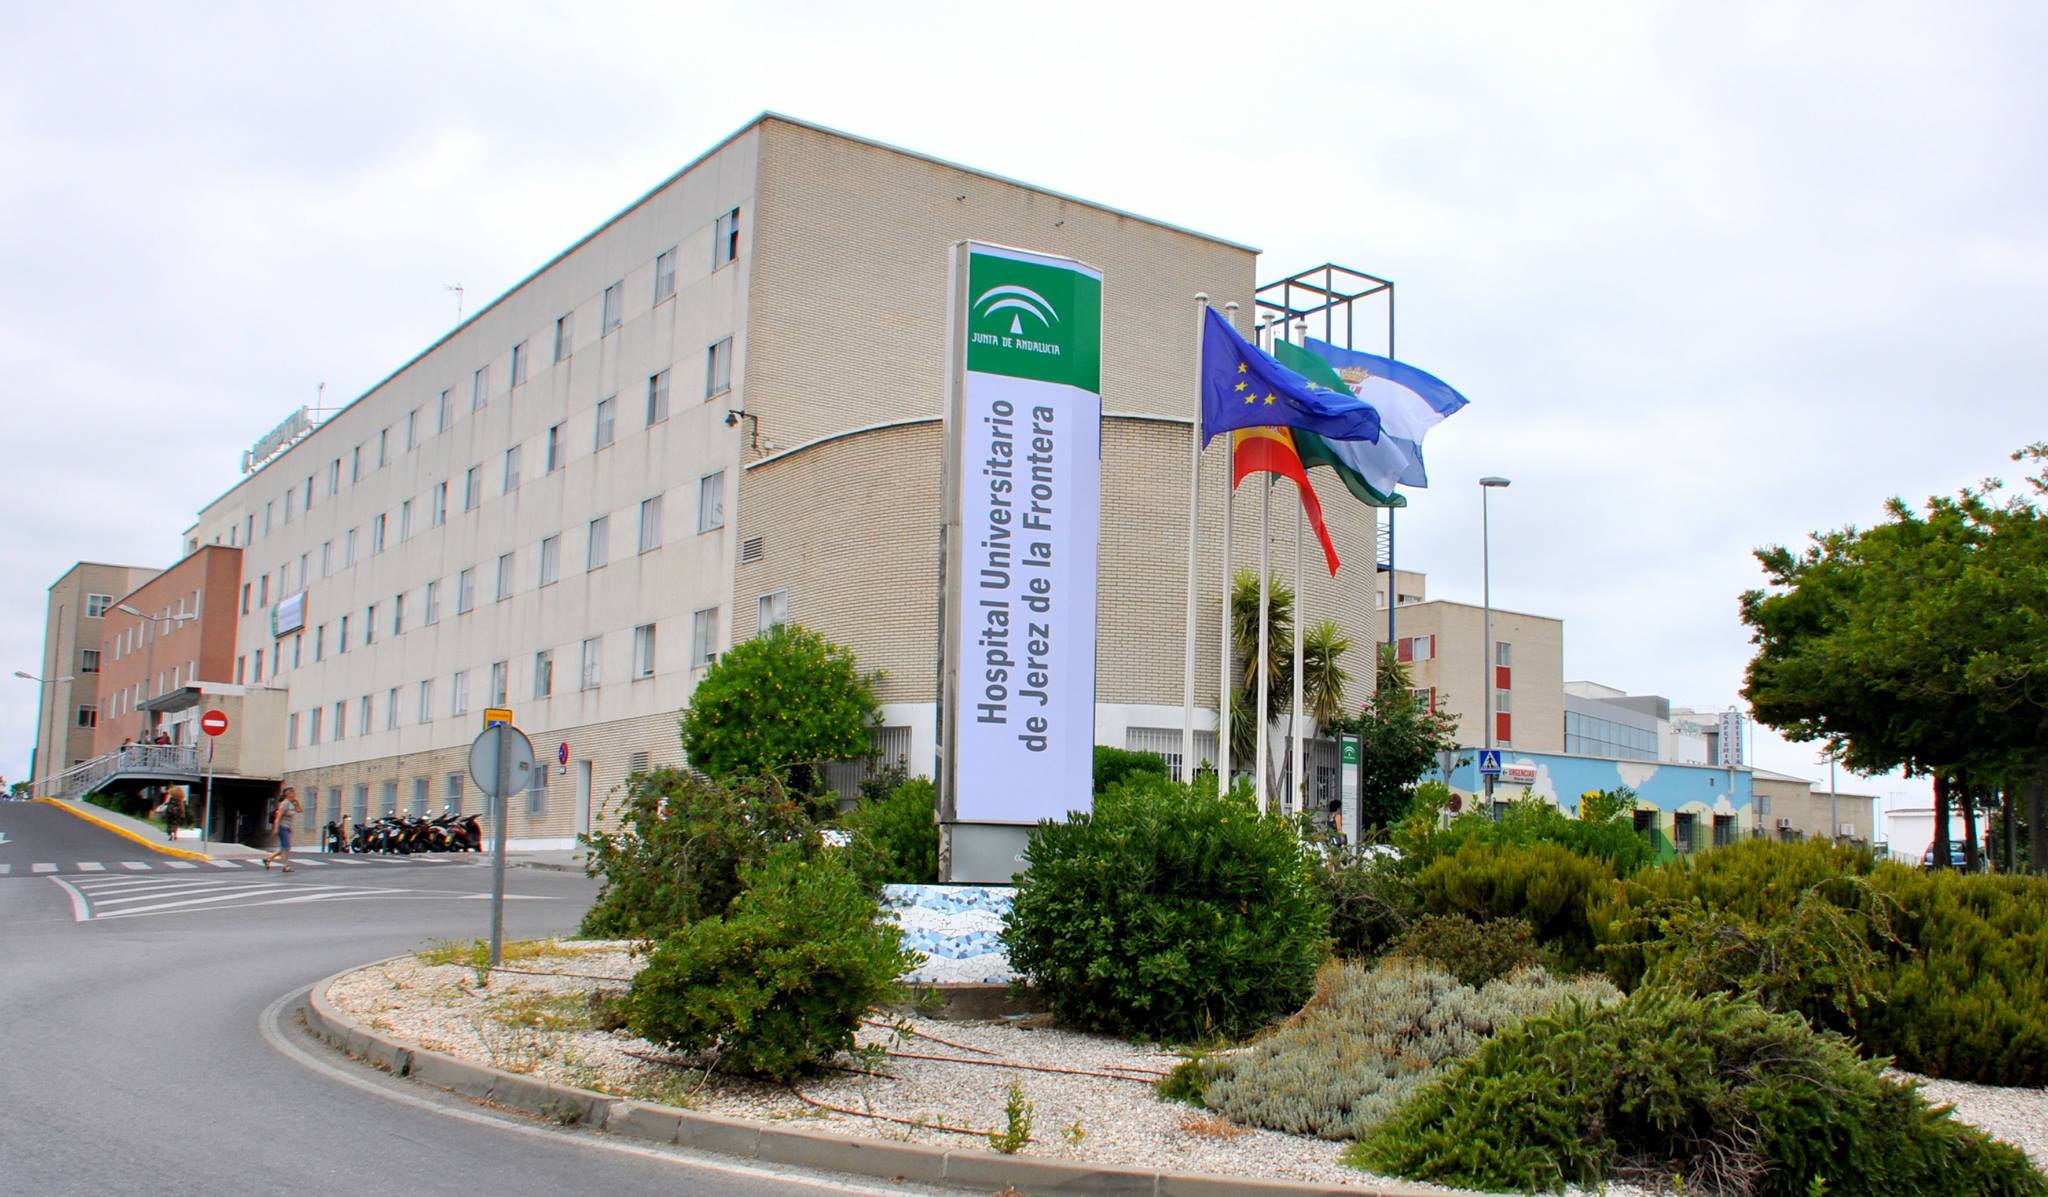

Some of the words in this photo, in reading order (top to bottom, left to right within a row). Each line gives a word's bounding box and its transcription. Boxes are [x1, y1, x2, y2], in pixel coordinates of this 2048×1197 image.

[972, 332, 999, 346] JUNTA
[1002, 337, 1013, 348] DE
[1022, 406, 1055, 532] Frontera
[979, 400, 1015, 591] Universitario
[1021, 542, 1053, 569] la
[1020, 577, 1052, 613] de
[976, 599, 1017, 724] Hospital
[1019, 622, 1051, 707] Jerez
[1019, 716, 1049, 752] de
[1508, 767, 1535, 778] URGENCIAS
